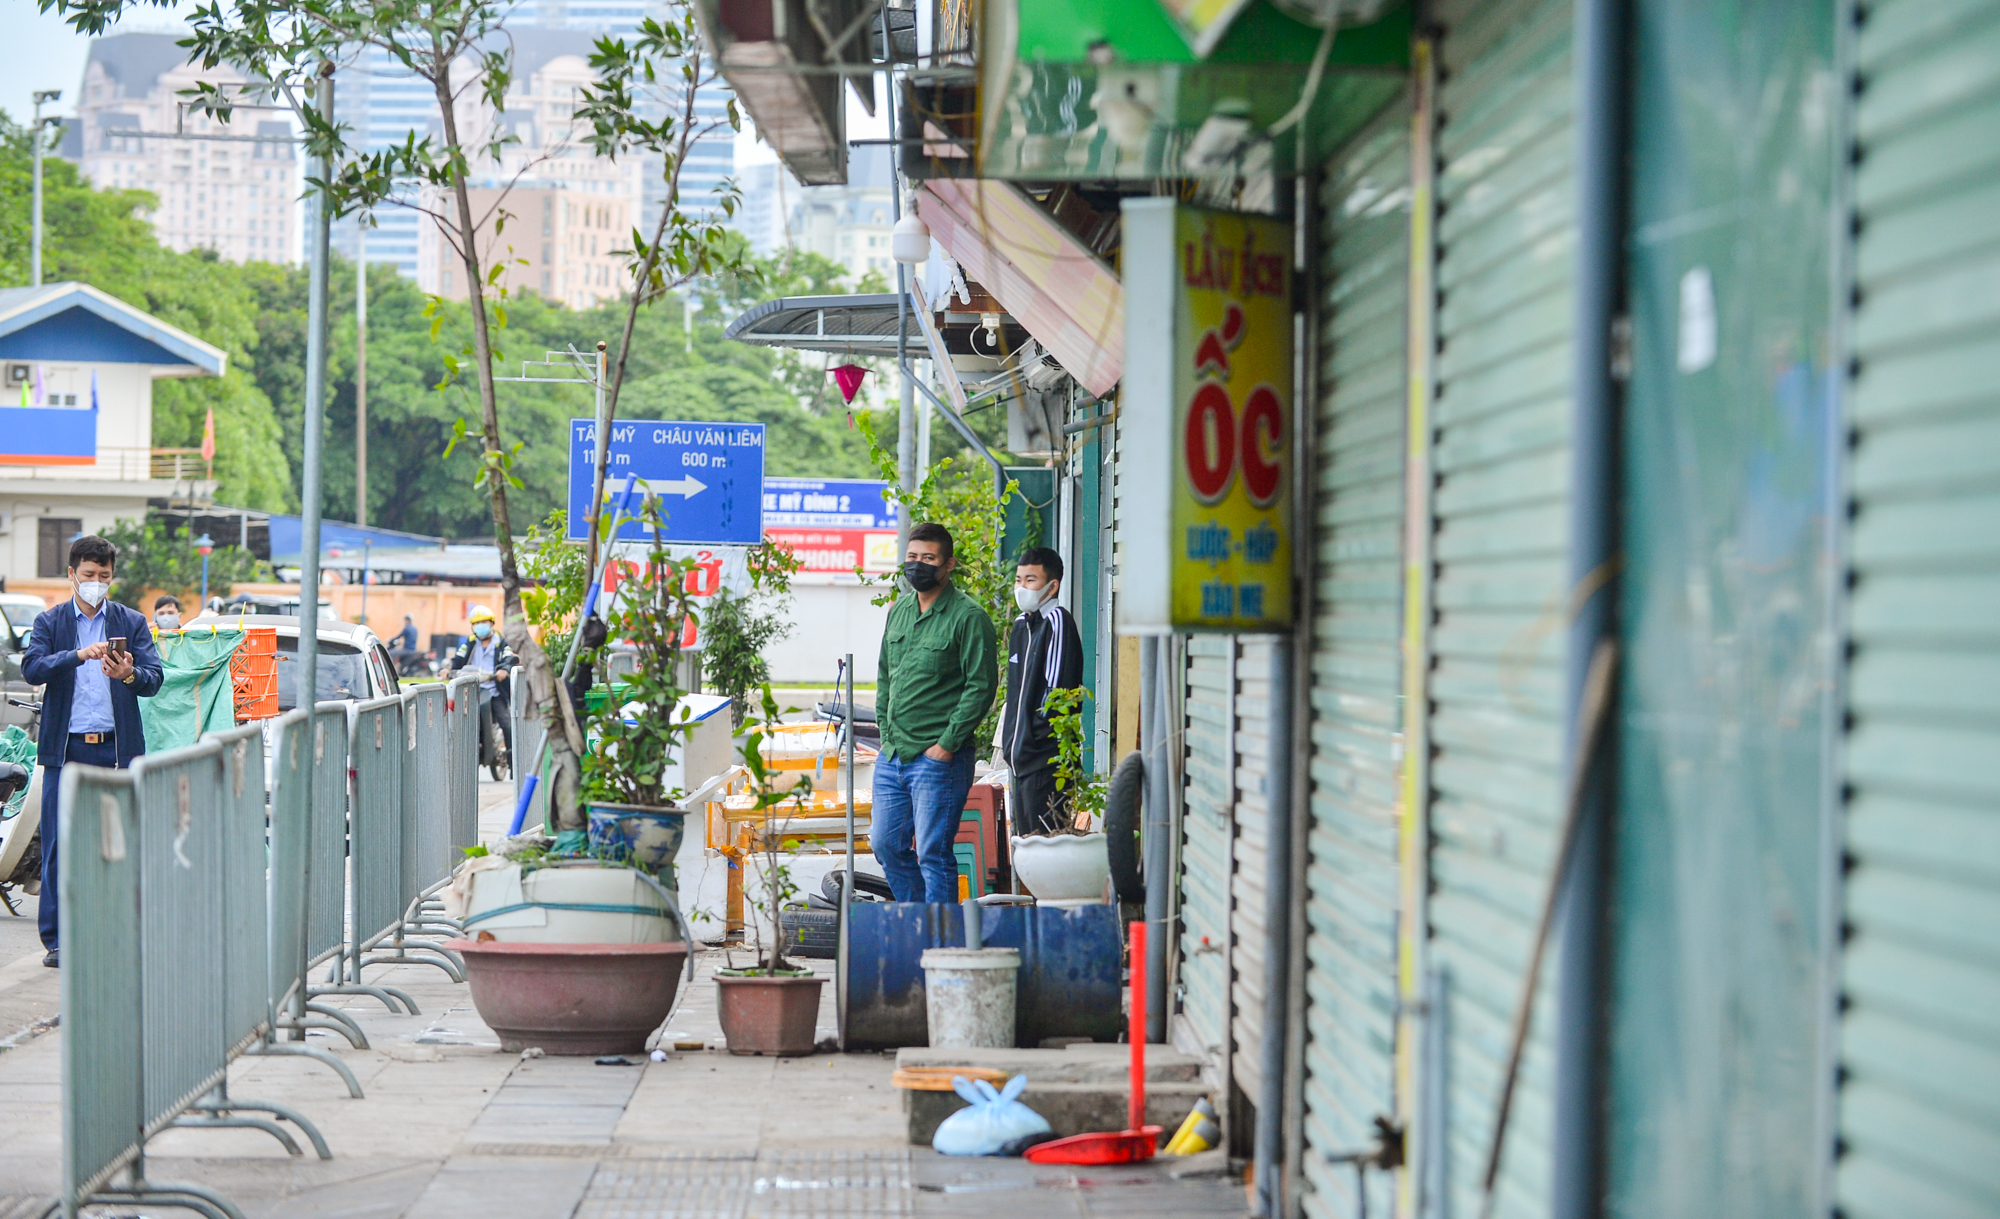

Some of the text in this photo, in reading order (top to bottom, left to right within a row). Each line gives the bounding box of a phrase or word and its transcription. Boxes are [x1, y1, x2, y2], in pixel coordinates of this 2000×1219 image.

[1185, 303, 1282, 501] ỐC
[575, 424, 636, 443] TÂ MỸ
[652, 427, 762, 447] CHÂU VĂN LIÊM
[583, 449, 630, 465] 110 m
[681, 452, 726, 468] 600 m
[779, 491, 802, 511] MỸ
[803, 492, 838, 512] ĐÌNH
[839, 495, 851, 512] 2
[793, 548, 857, 571] PHONG
